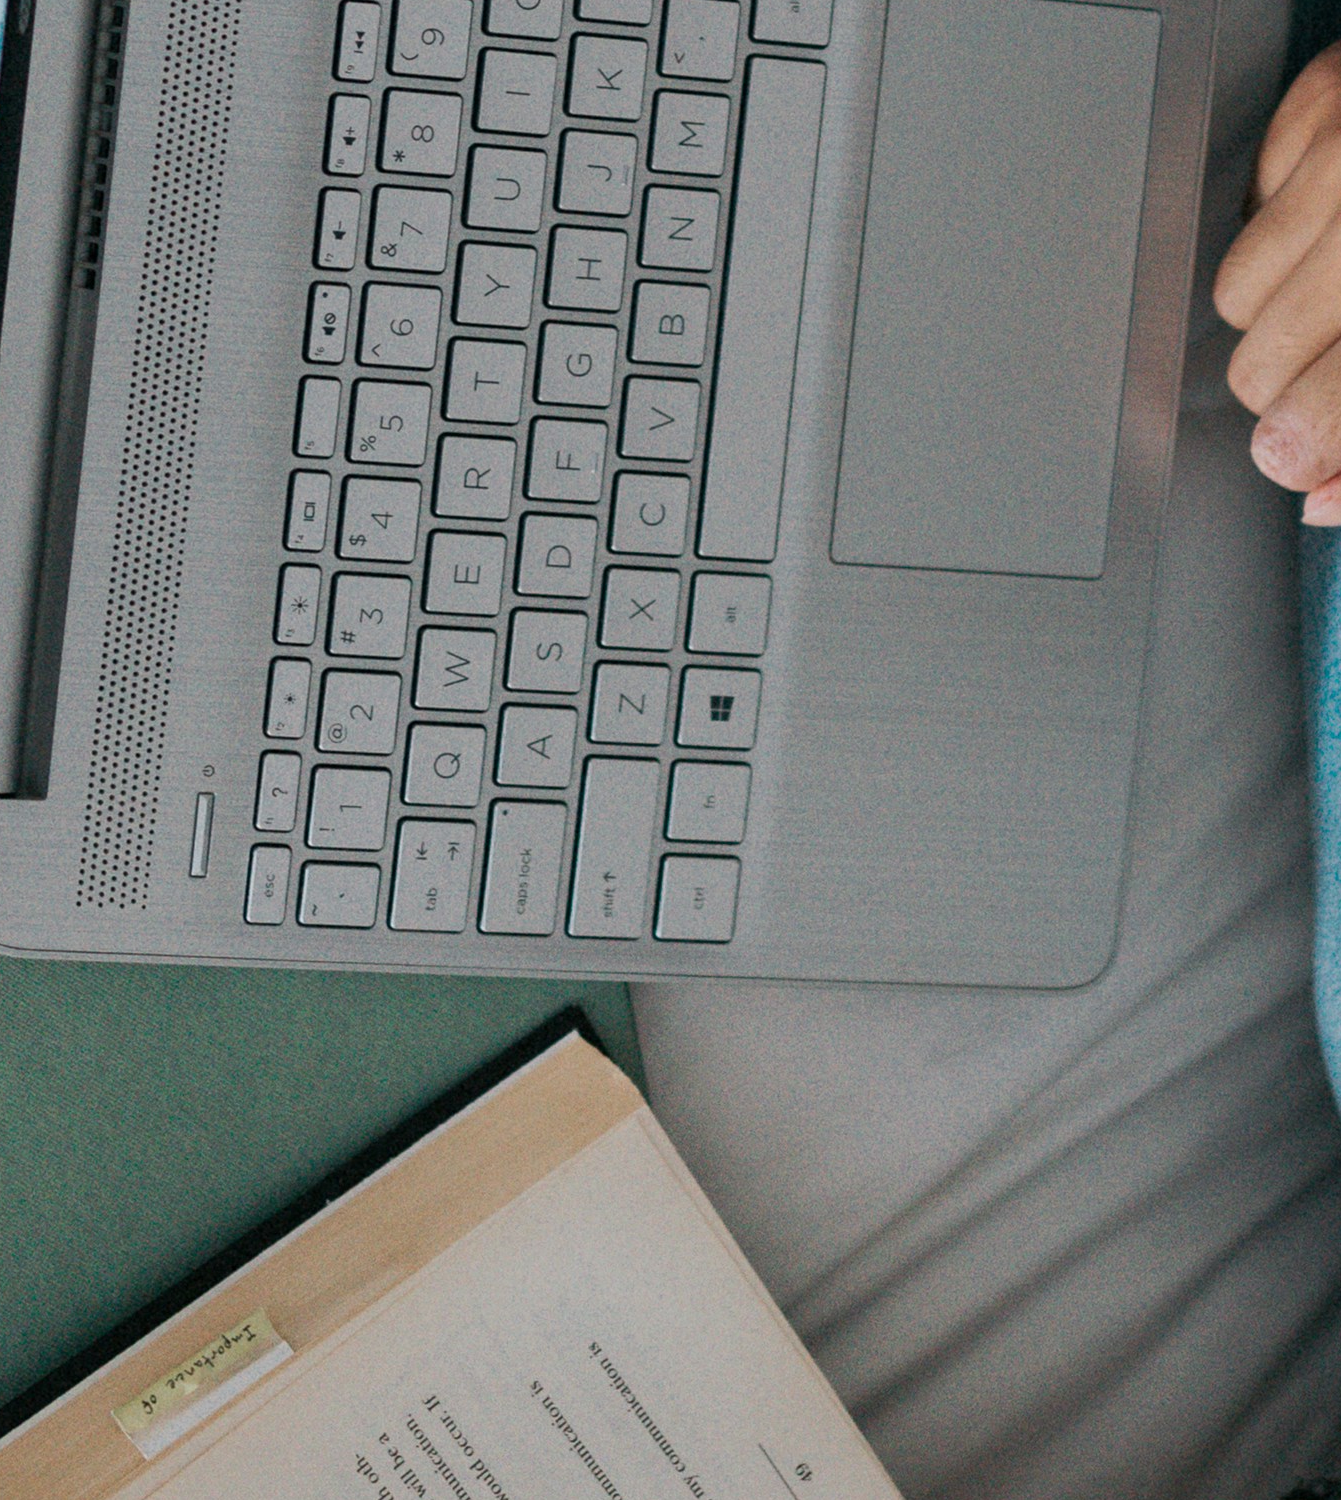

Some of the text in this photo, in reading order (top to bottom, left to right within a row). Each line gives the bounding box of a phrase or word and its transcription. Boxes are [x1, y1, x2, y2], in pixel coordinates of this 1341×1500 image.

[420, 26, 446, 47] 9
[596, 67, 623, 92] K
[505, 89, 531, 97] I
[410, 123, 436, 144] 8
[677, 120, 705, 149] M
[586, 163, 614, 183] J
[493, 176, 522, 202] U
[398, 219, 424, 238] 7
[667, 216, 696, 242] N
[575, 256, 602, 282] H
[483, 273, 511, 298] Y
[389, 318, 415, 338] 6
[657, 313, 686, 337] B
[564, 352, 594, 379] G
[472, 371, 501, 392] T
[378, 414, 405, 432] 5
[648, 405, 676, 432] V
[554, 450, 581, 472] F
[462, 466, 491, 491] R
[369, 511, 394, 531] 4
[638, 502, 667, 528] C
[544, 543, 573, 570] D
[452, 564, 482, 586] E
[358, 607, 385, 625] 3
[628, 598, 656, 622] X
[535, 641, 564, 662] S
[443, 650, 472, 688] W
[348, 703, 375, 722] 2
[617, 692, 646, 716] Z
[525, 734, 553, 760] A
[432, 751, 462, 781] Q
[338, 803, 363, 813] 1
[516, 848, 532, 916] caps lock
[424, 886, 439, 912] tab
[601, 887, 617, 919] shift
[140, 1324, 257, 1415] Importance of
